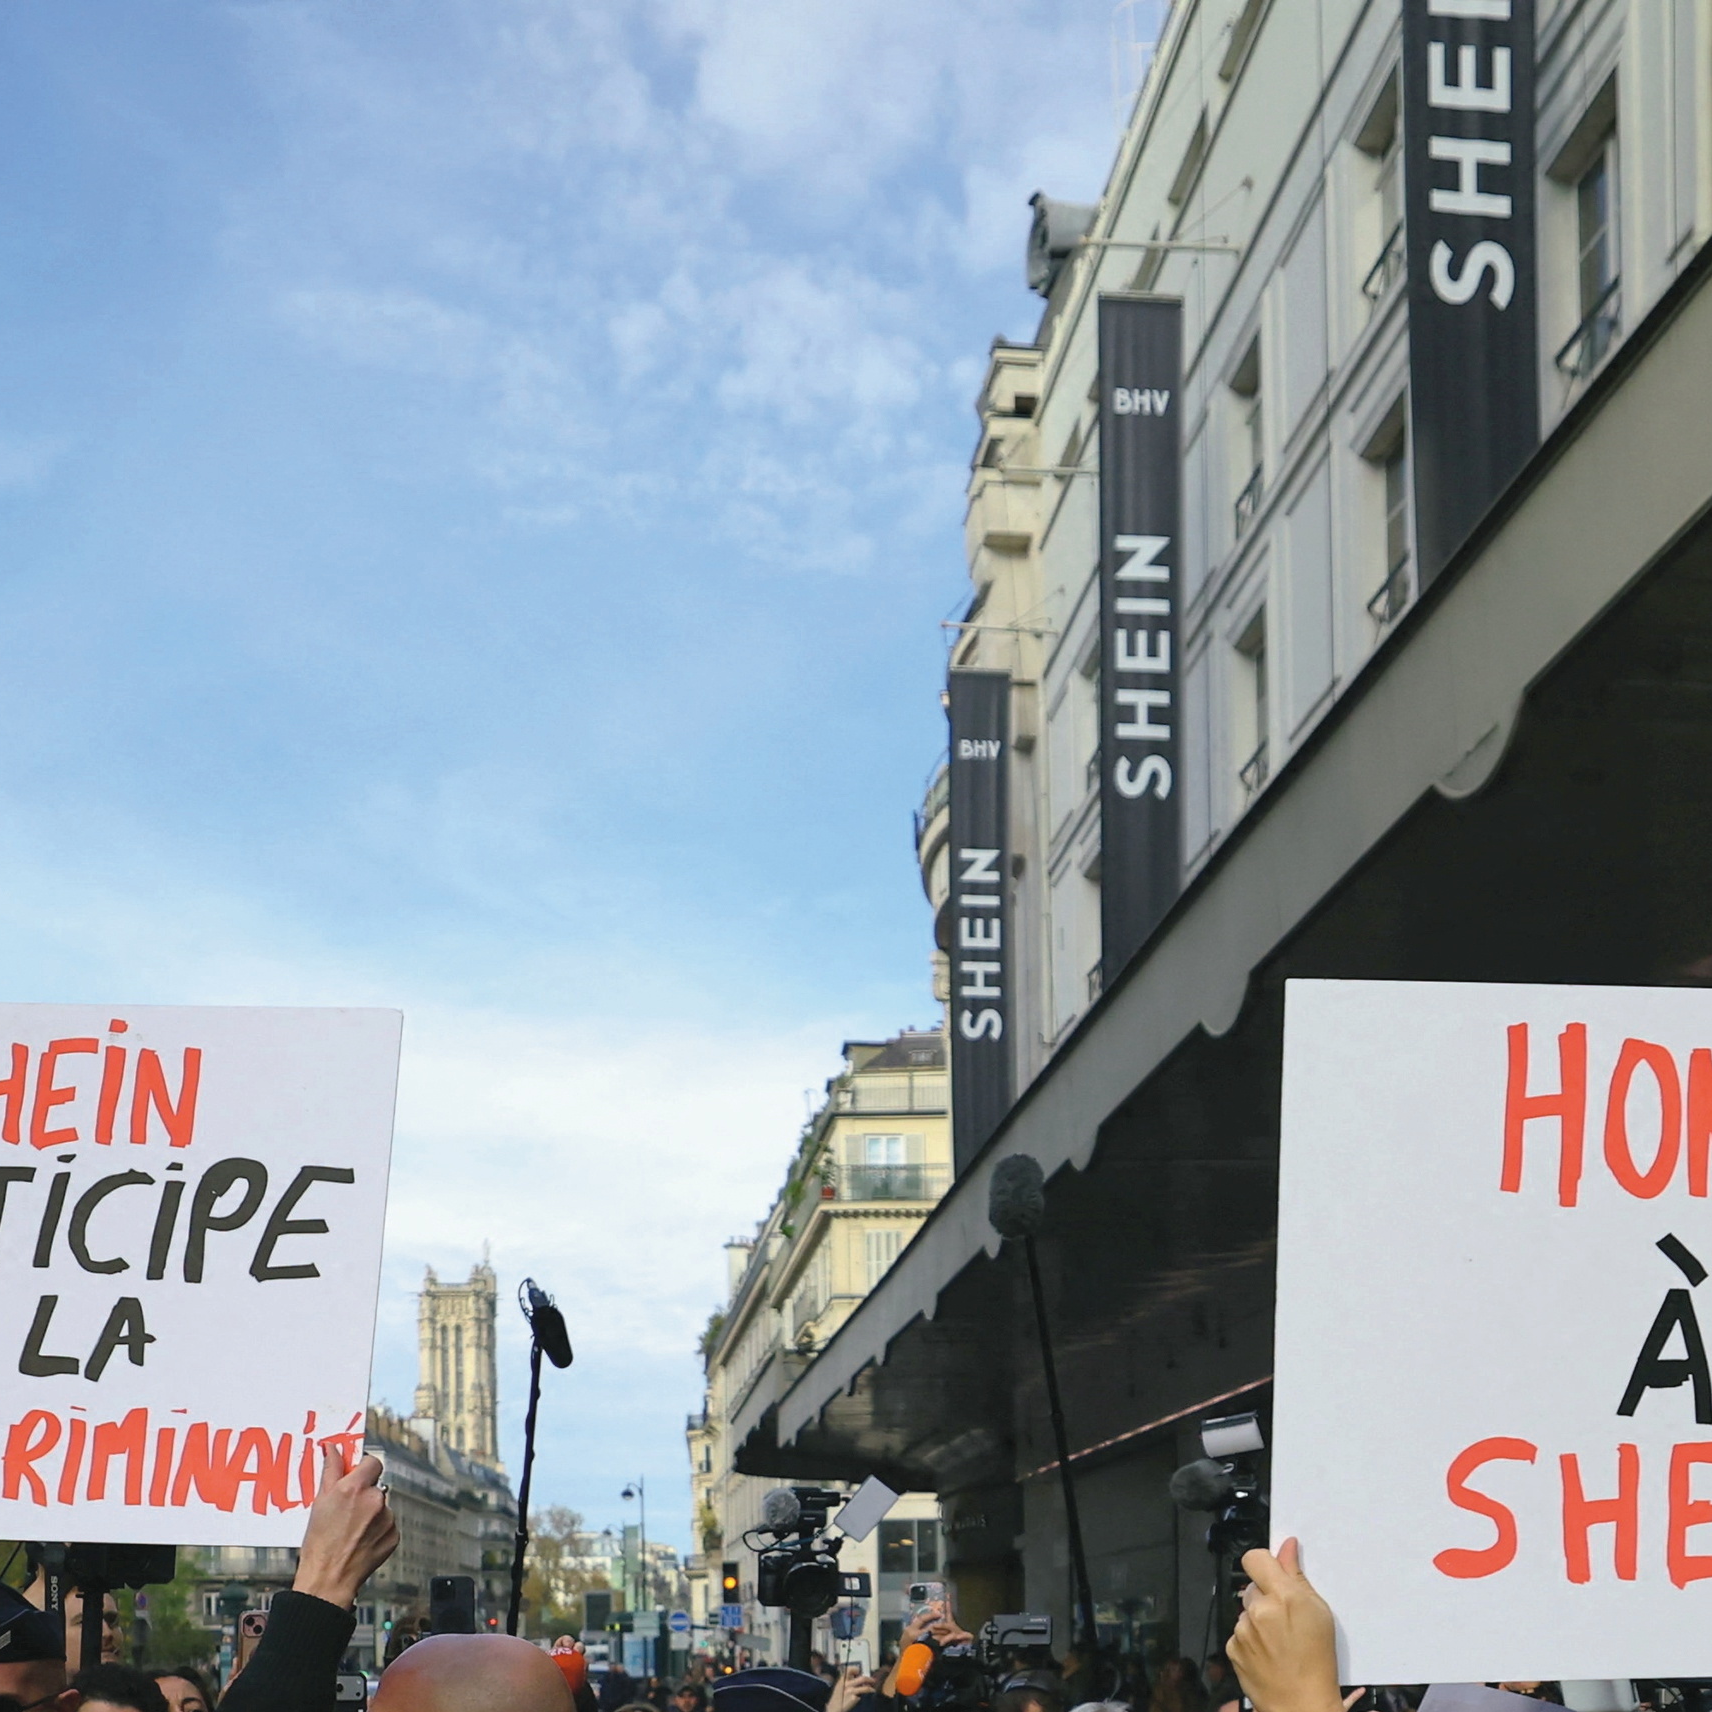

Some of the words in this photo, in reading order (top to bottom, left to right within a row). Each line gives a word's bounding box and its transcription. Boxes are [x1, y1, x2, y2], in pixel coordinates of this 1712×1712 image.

[1427, 0, 1515, 309] SHEI
[1112, 386, 1170, 416] BHV
[1113, 533, 1172, 800] SHEIN
[958, 739, 1001, 761] BHV
[959, 847, 1003, 1041] SHEIN
[18, 1294, 157, 1383] LA
[50, 1575, 59, 1611] SONY
